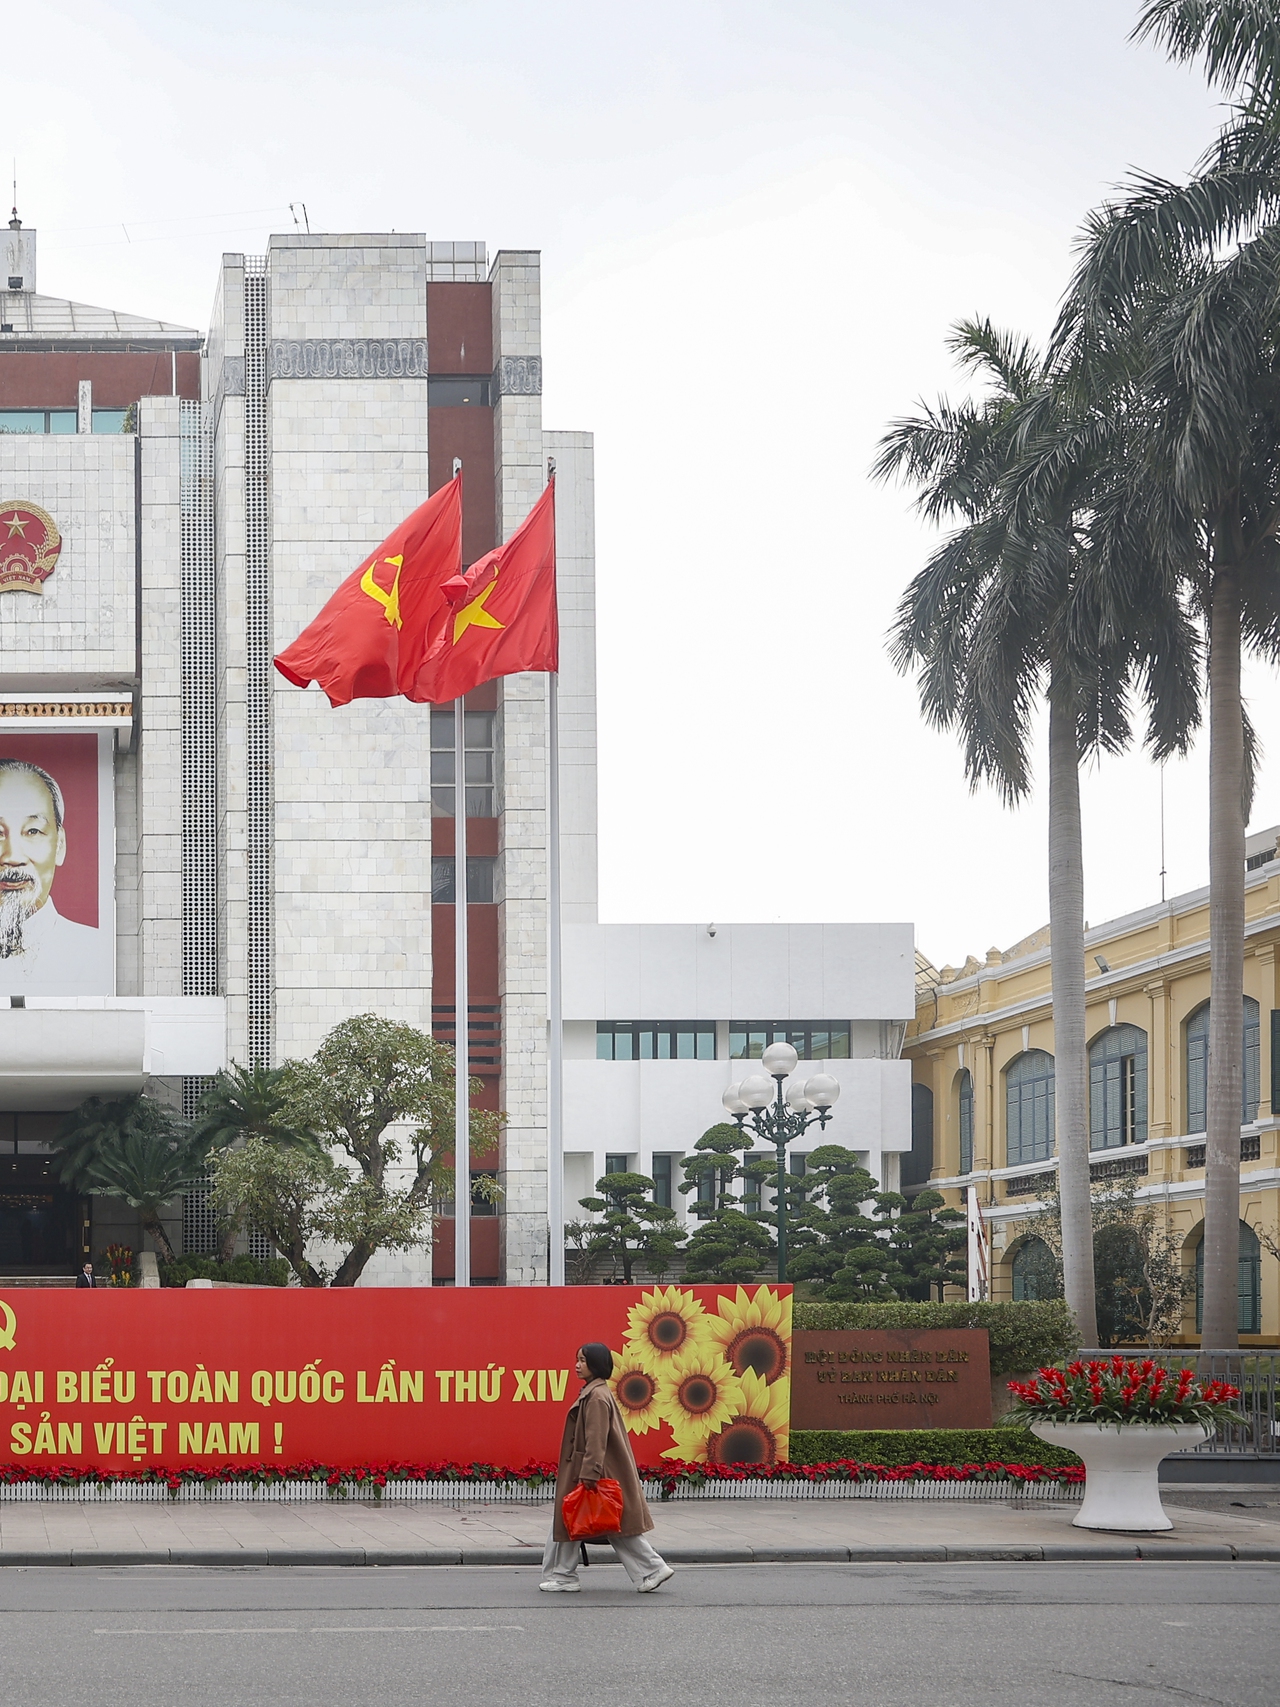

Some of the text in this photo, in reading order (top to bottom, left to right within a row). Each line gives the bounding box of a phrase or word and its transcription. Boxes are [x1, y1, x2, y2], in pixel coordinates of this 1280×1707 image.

[805, 1347, 969, 1366] HỘI ĐỒNG NHÂN DÂN
[56, 1357, 136, 1404] BIỂU
[146, 1363, 239, 1404] TOÀN
[251, 1358, 345, 1407] QUỐC
[356, 1358, 424, 1403] LẦN
[434, 1362, 506, 1403] THỨ
[511, 1369, 570, 1402] XIV
[841, 1371, 873, 1383] BAN
[877, 1368, 922, 1382] NHÂN
[925, 1368, 959, 1382] DÂN
[838, 1391, 939, 1406] THÀNH PHỐ HÀ NỘI
[10, 1411, 82, 1455] SẢN
[93, 1415, 168, 1462] VIỆT
[178, 1422, 260, 1455] NAM
[274, 1422, 284, 1454] !
